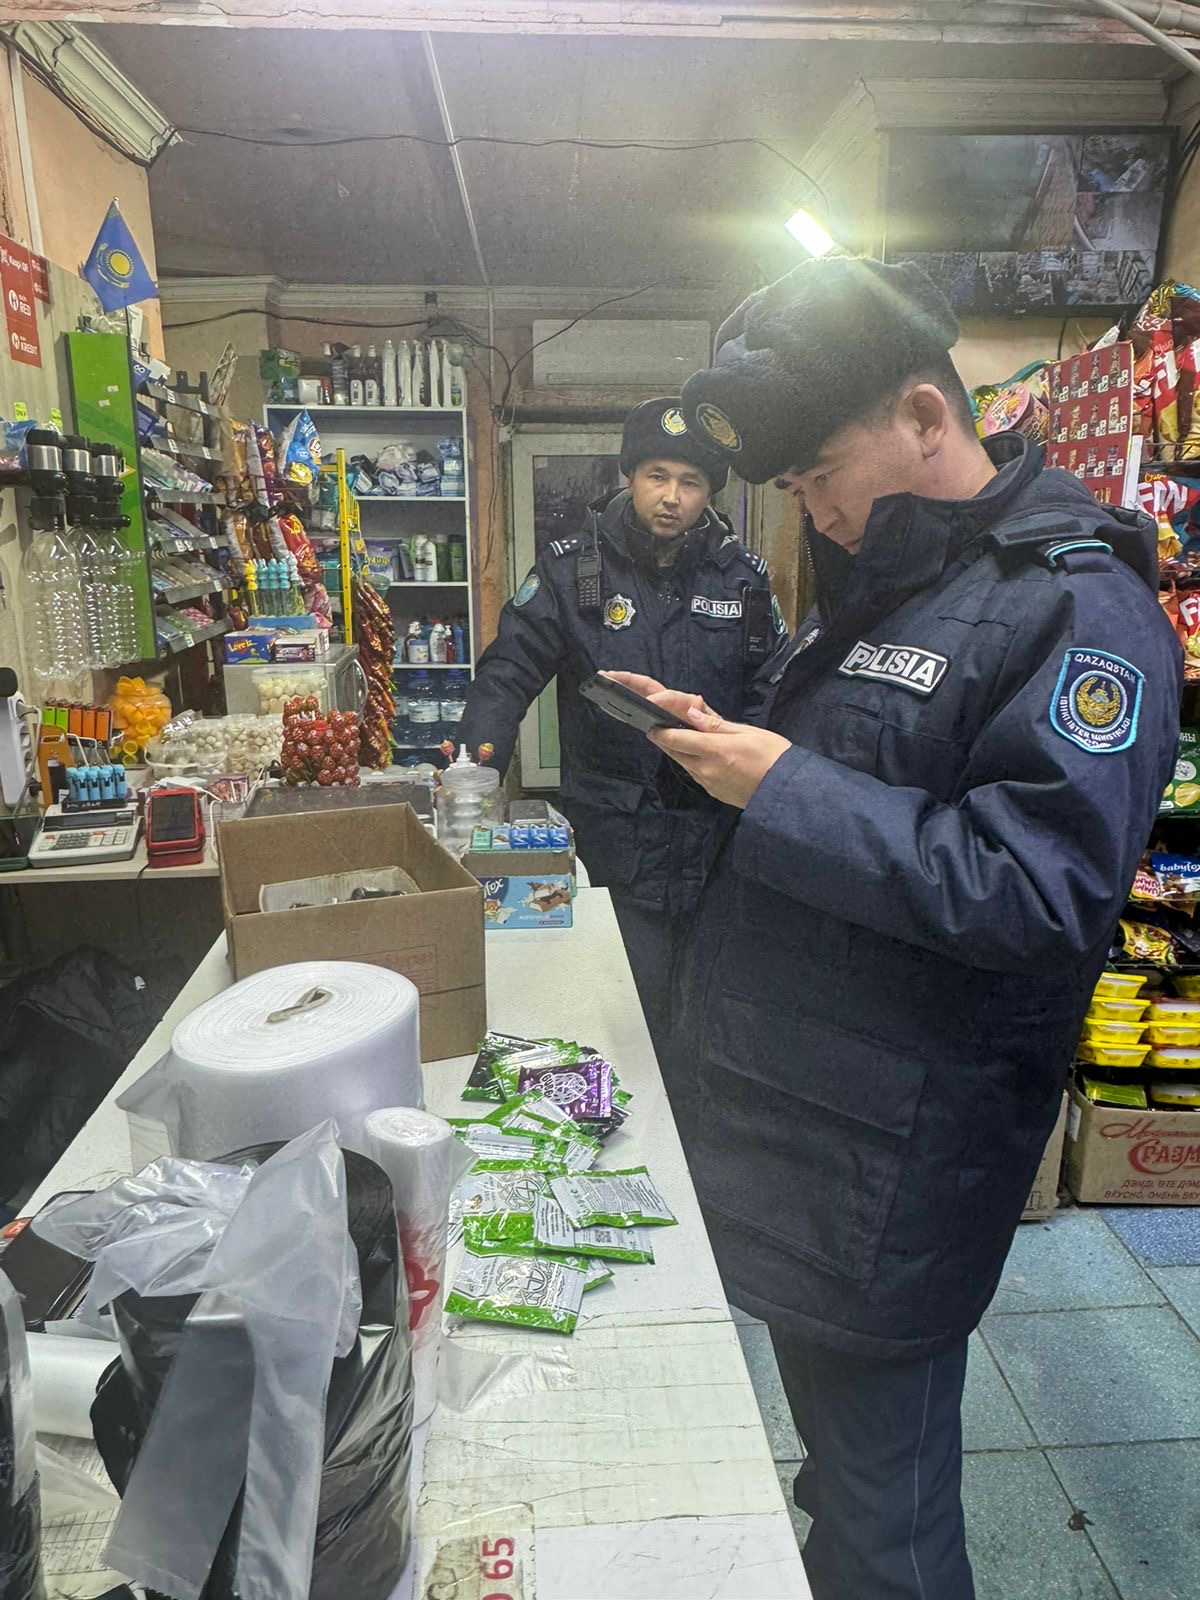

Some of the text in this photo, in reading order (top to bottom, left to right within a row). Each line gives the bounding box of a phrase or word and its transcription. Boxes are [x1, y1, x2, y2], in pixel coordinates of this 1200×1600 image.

[693, 598, 739, 615] POLISIA
[845, 647, 937, 686] PLISIA
[1074, 653, 1136, 683] QAZAQSTAN
